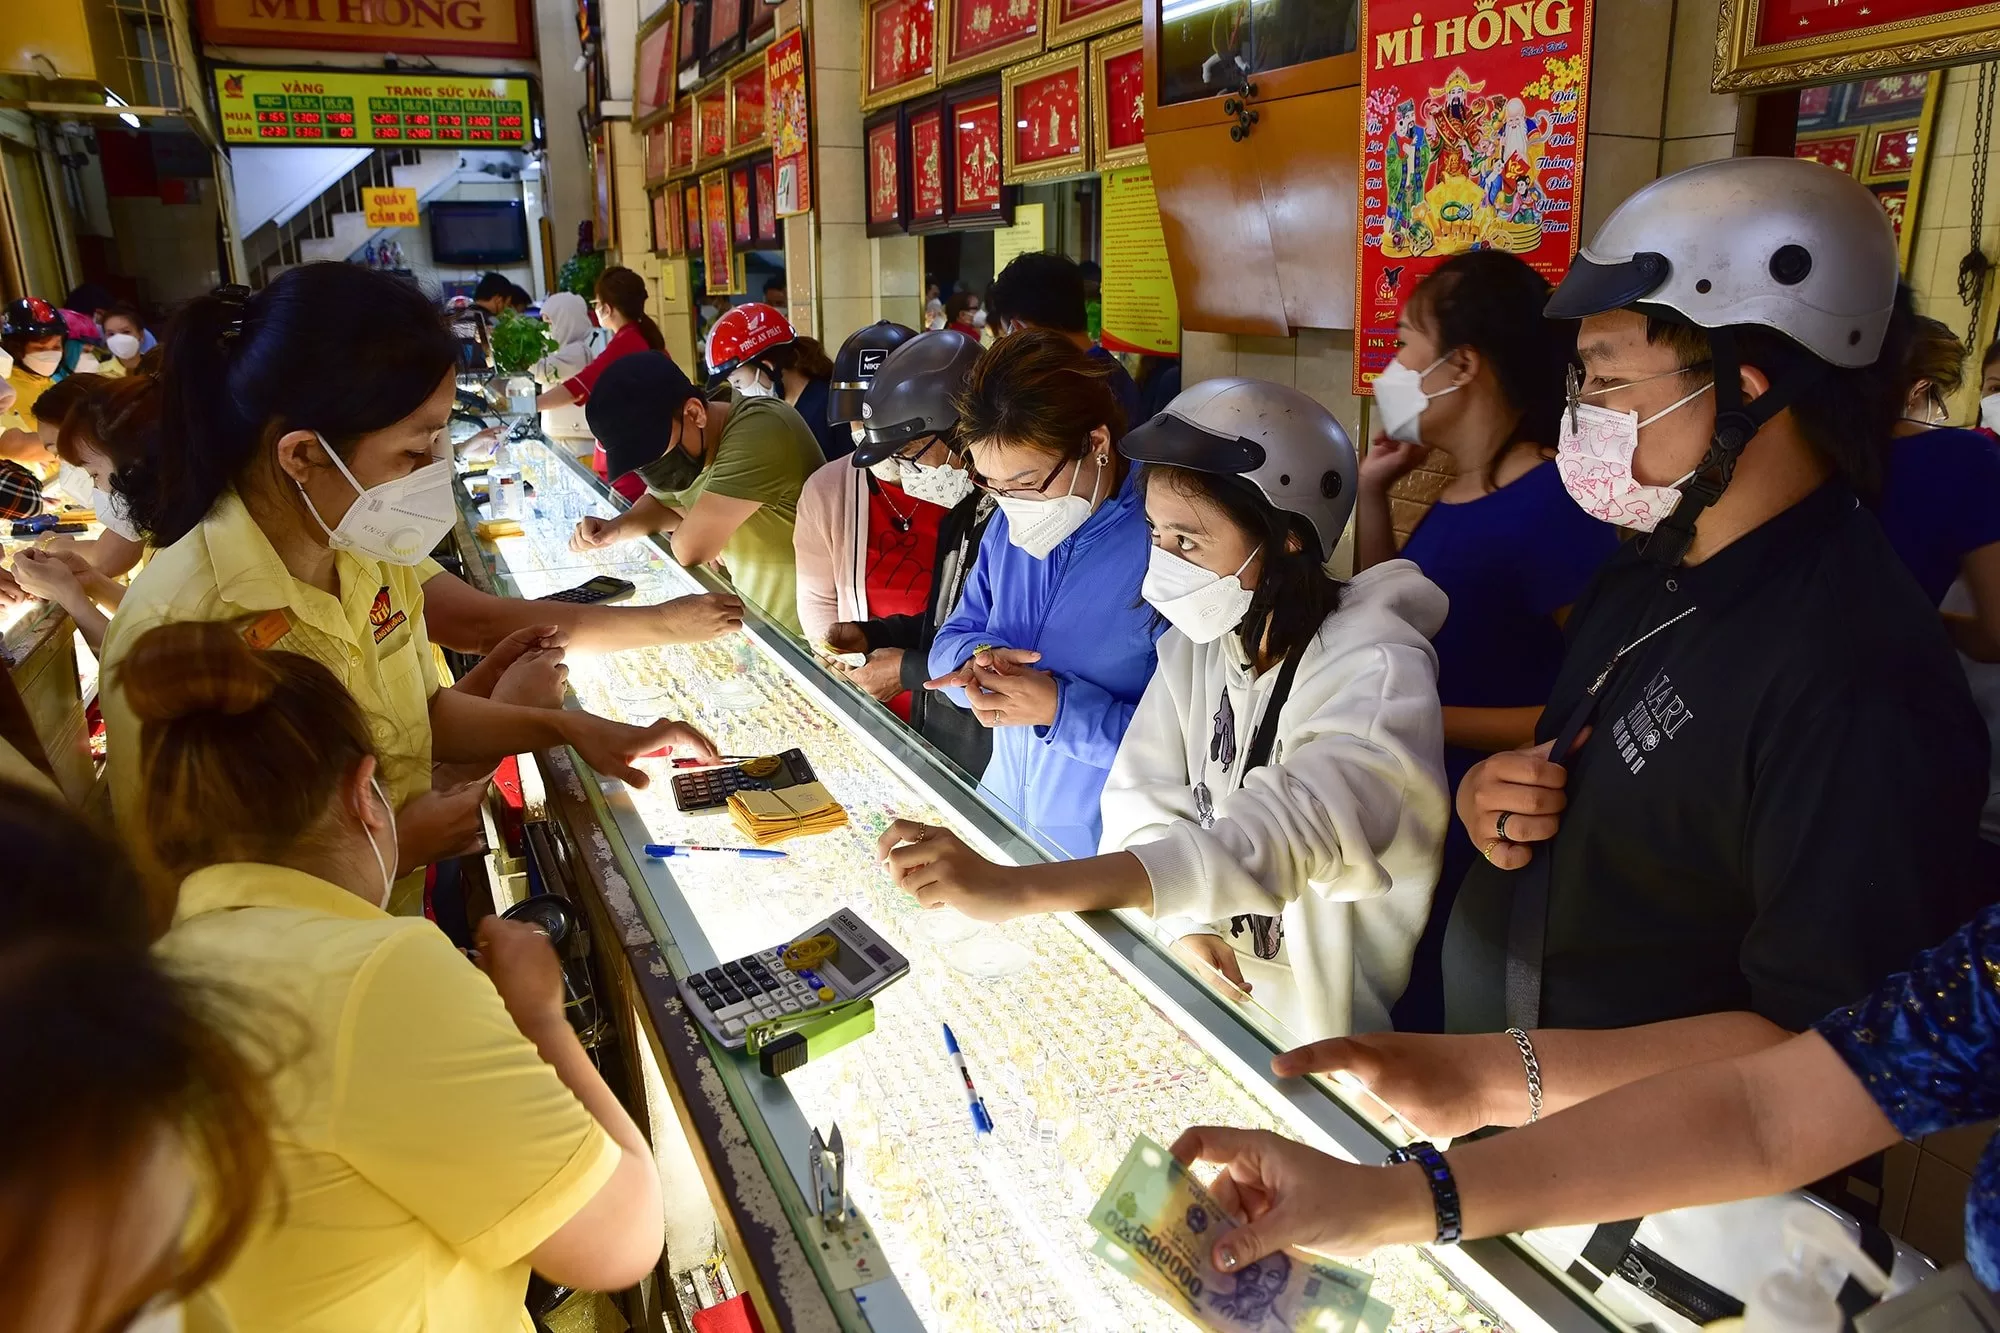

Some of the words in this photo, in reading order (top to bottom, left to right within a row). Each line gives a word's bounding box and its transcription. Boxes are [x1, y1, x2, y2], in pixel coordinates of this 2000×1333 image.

[385, 85, 432, 97] TRANG
[224, 112, 252, 121] MUA
[362, 524, 388, 539] KN95
[838, 914, 858, 932] CASIO
